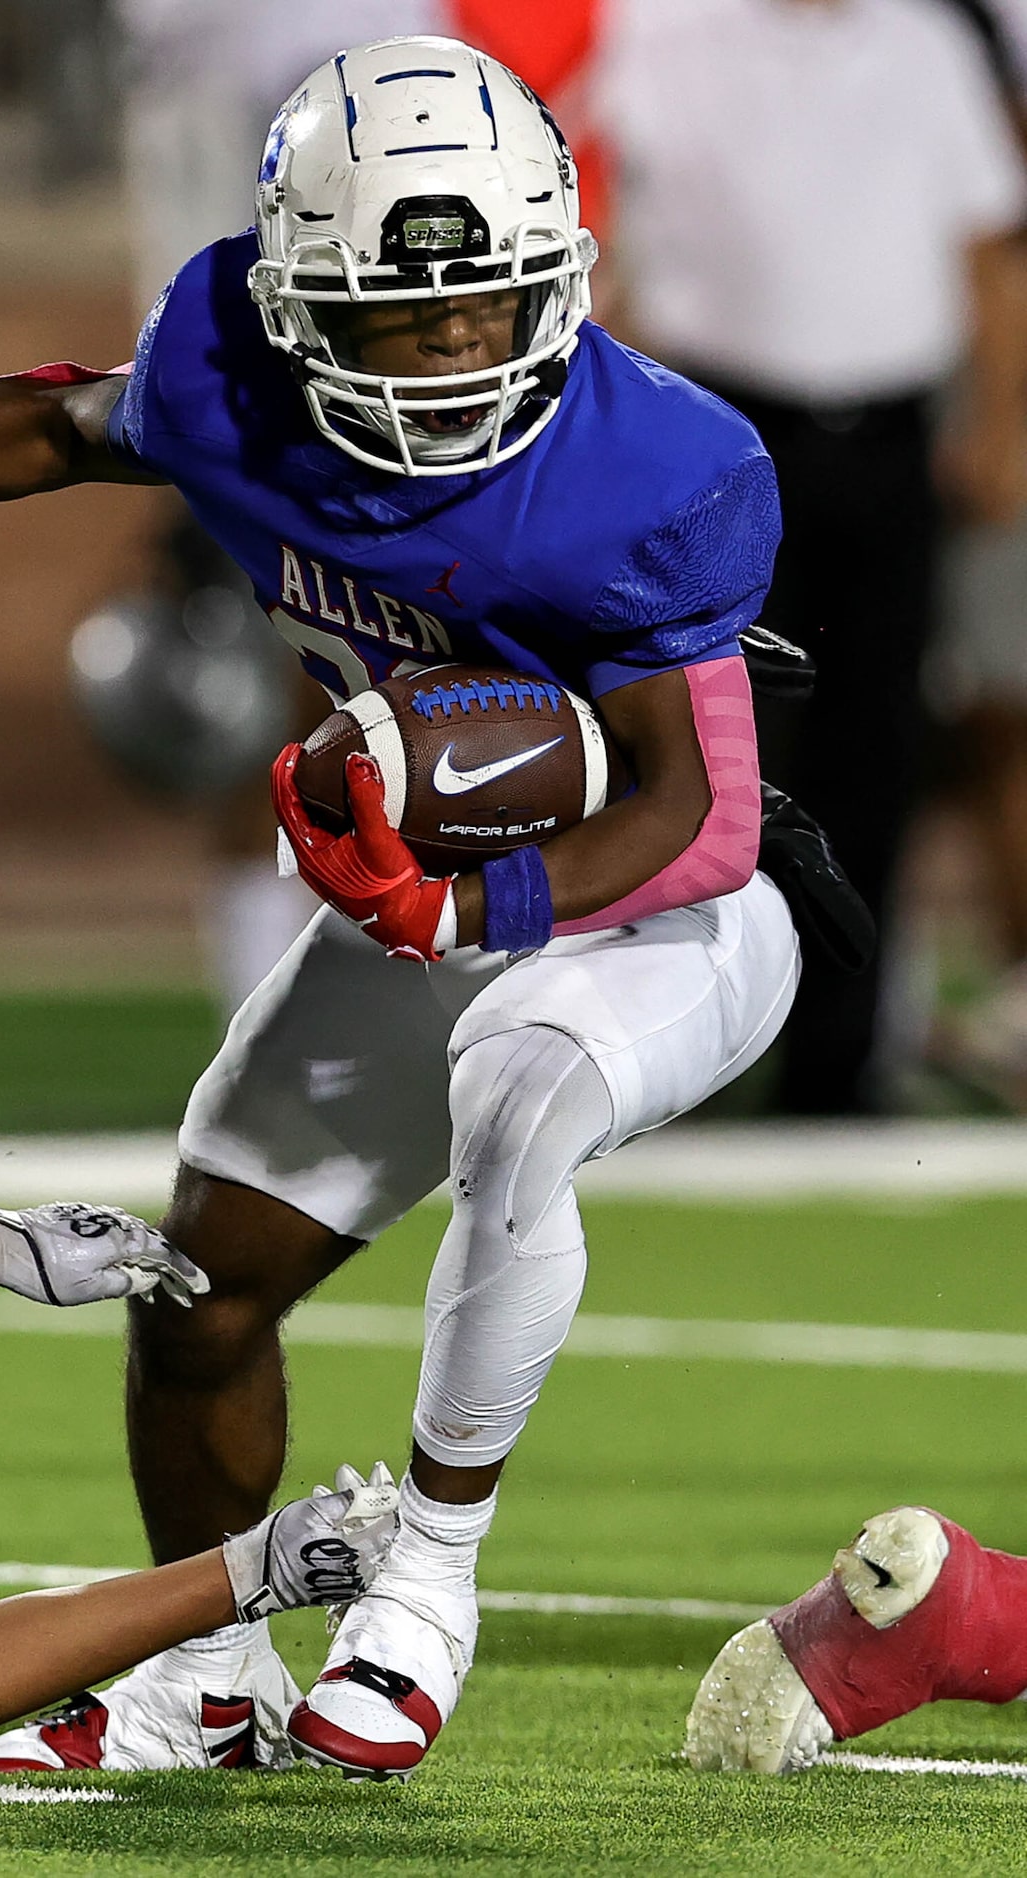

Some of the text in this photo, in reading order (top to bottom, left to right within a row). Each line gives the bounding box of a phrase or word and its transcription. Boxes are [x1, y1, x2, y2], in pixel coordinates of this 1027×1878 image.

[281, 546, 452, 656] ALLEN
[439, 816, 557, 837] VAPOR ELITE
